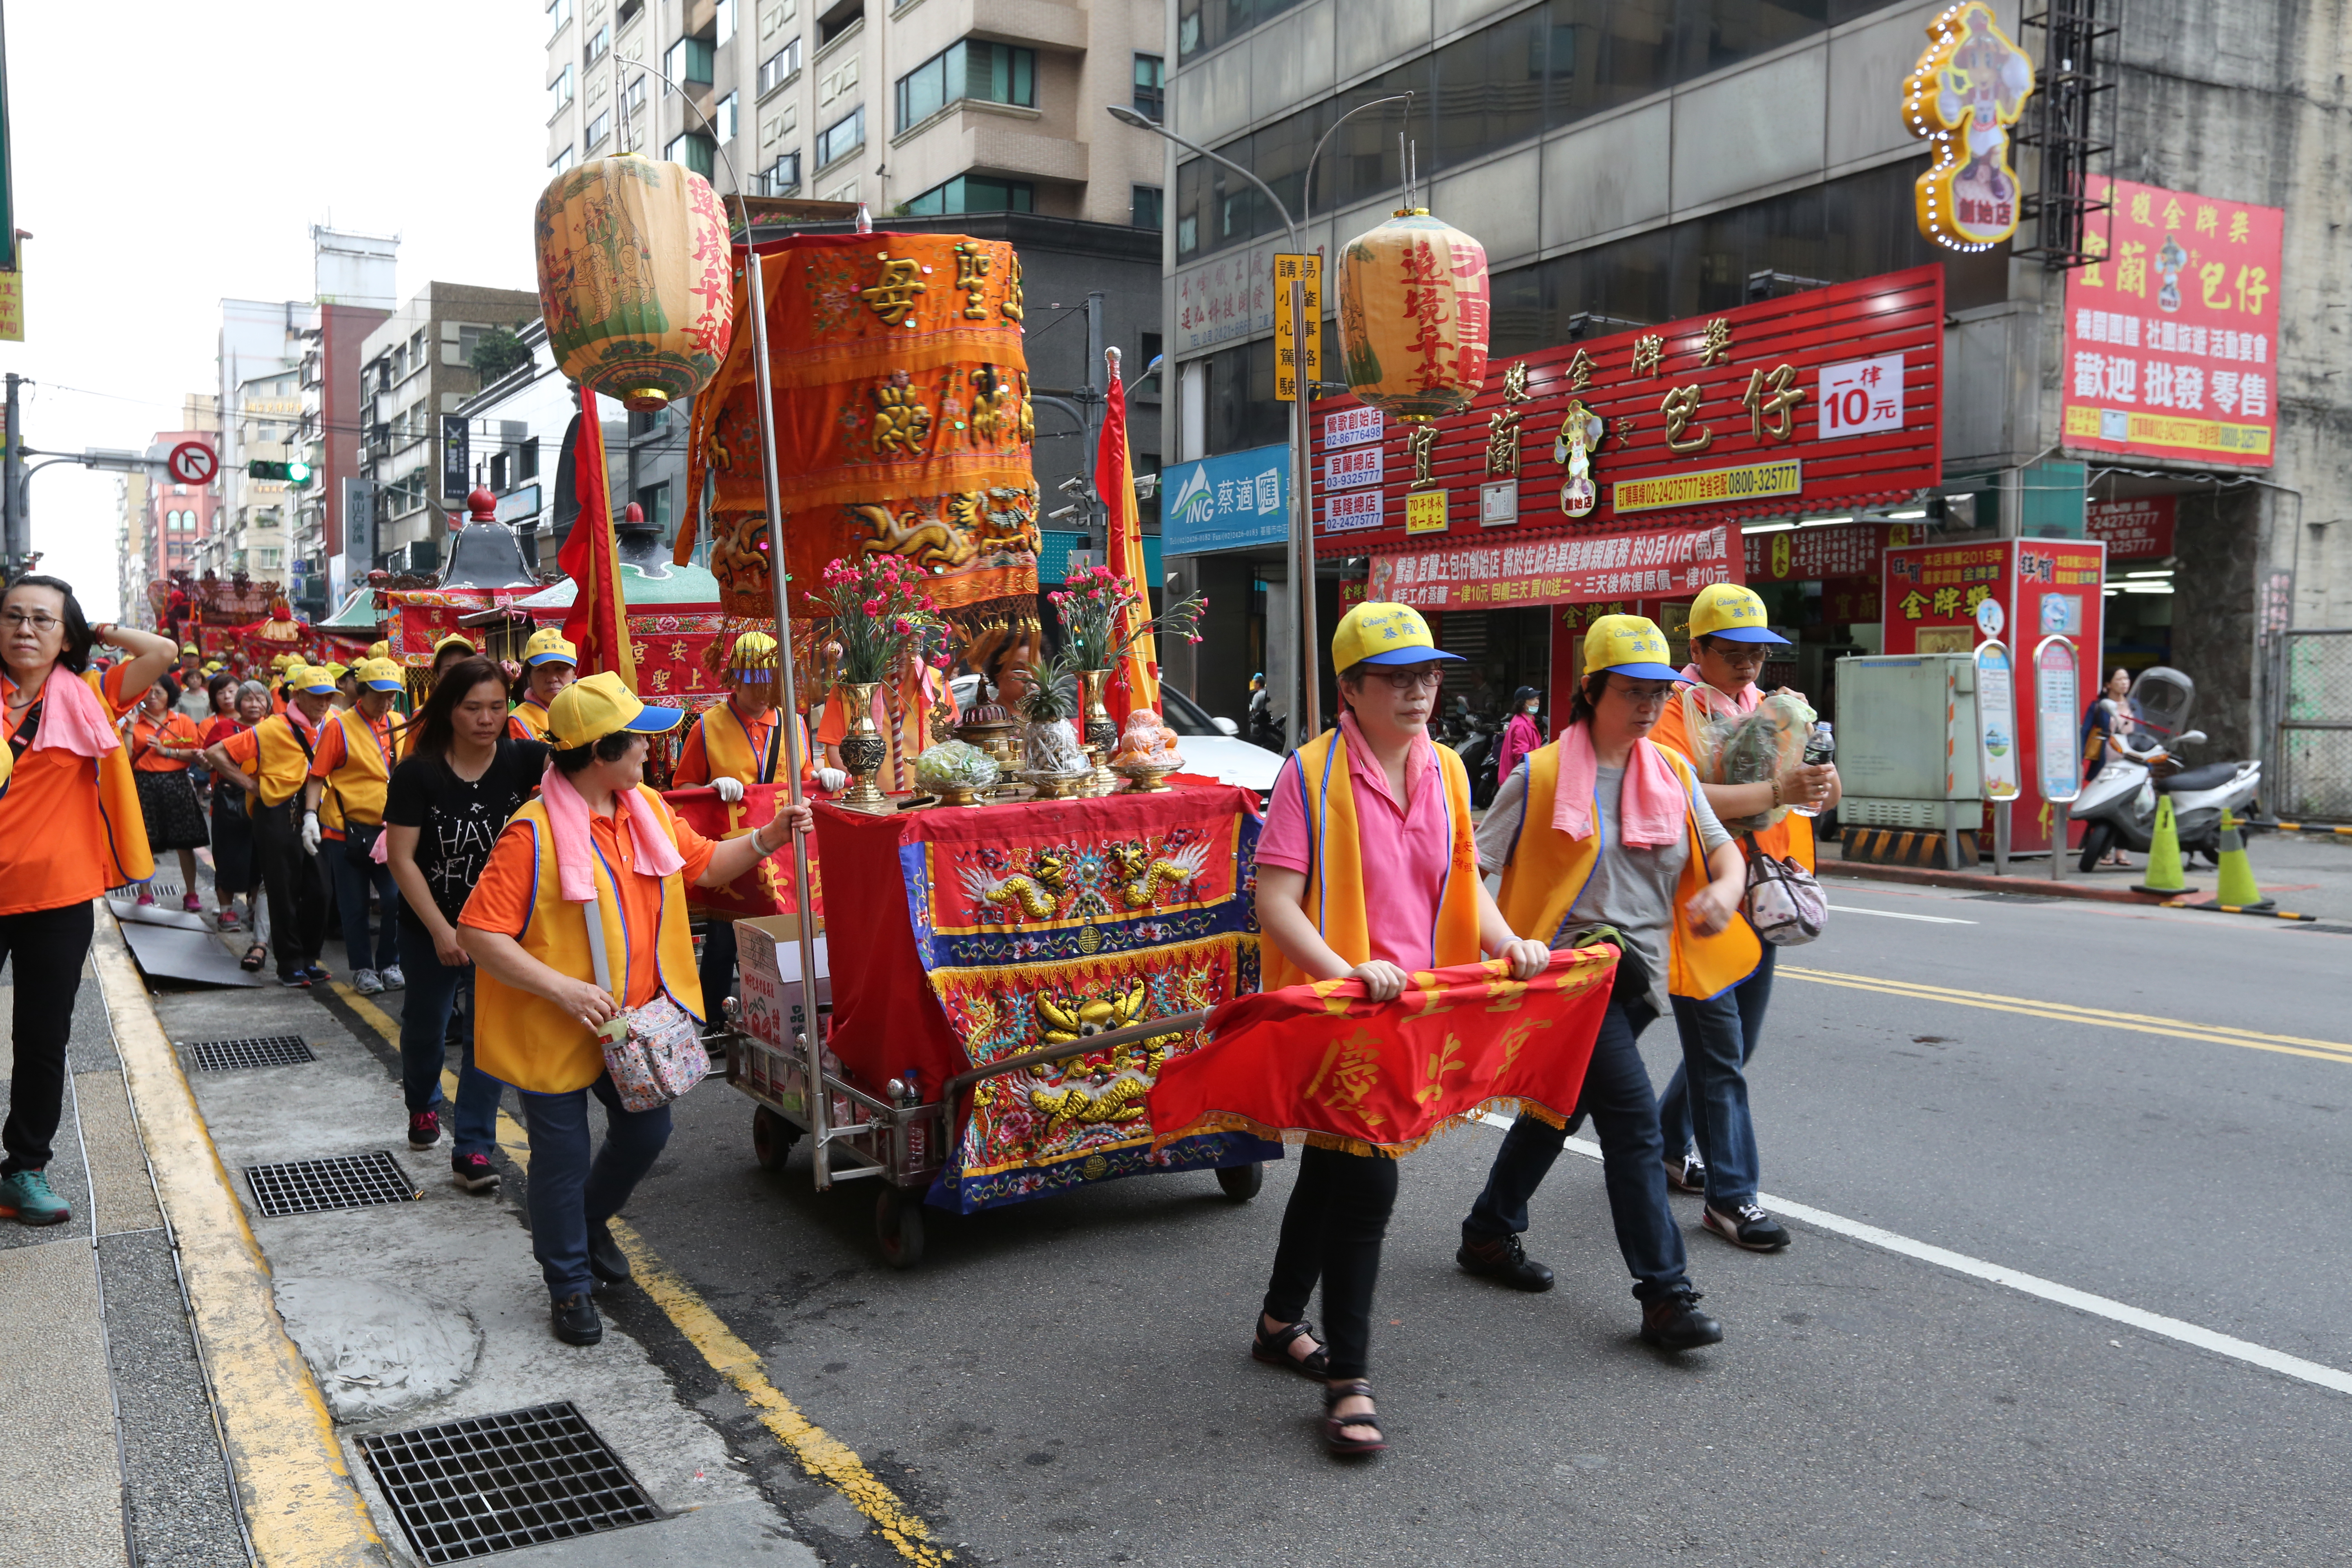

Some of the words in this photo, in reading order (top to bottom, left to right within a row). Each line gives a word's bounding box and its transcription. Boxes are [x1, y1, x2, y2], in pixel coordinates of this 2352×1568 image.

[2199, 261, 2271, 316] 包仔
[2209, 329, 2268, 363] 活動宴會
[1833, 366, 1885, 389] 一律
[2074, 350, 2138, 403] 歡迎
[2143, 359, 2204, 412] 批發
[2210, 370, 2268, 418] 零售
[1660, 363, 1807, 454] 包仔
[1823, 388, 1898, 430] 10元
[1327, 409, 1381, 434] 鶯歌創始店
[1327, 427, 1381, 446] 02-86776498
[1332, 452, 1375, 475] 宜蘭總店
[1327, 470, 1380, 488] 03-9325777
[1217, 470, 1276, 514] 蔡適應
[1332, 494, 1376, 517] 基隆總店
[1260, 523, 1289, 536] 基隆市中正
[1327, 512, 1381, 530] 02-24275777
[1394, 556, 1417, 584] 鶯歌
[1452, 584, 1489, 603] 一律10元
[1530, 577, 1572, 598] 買10送二
